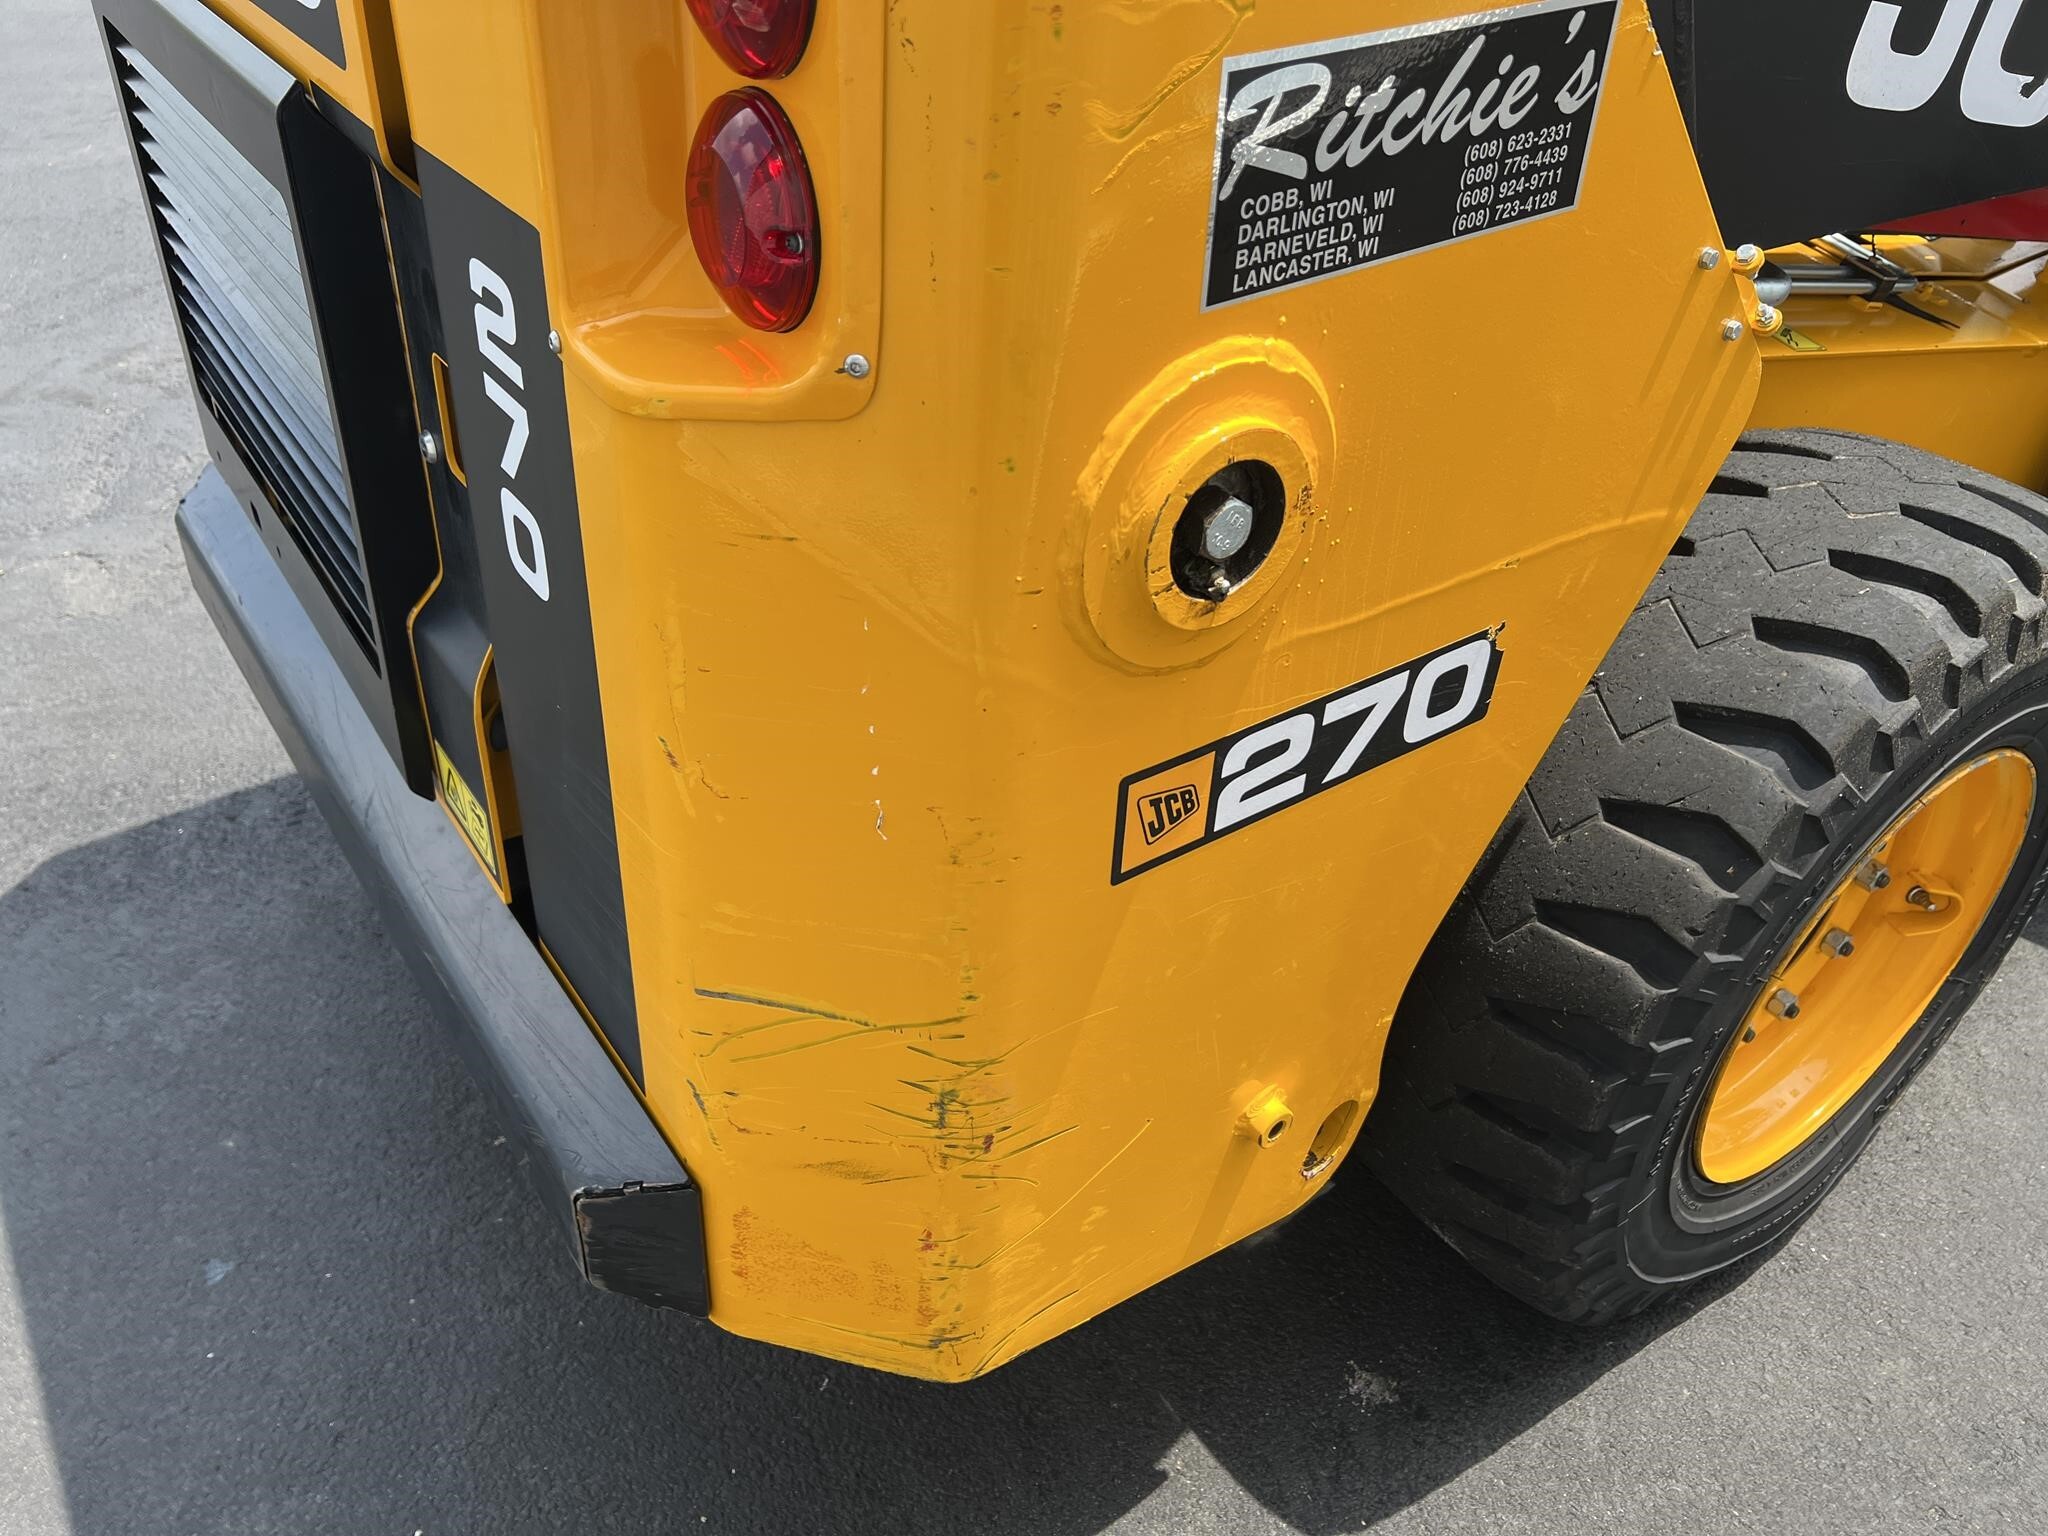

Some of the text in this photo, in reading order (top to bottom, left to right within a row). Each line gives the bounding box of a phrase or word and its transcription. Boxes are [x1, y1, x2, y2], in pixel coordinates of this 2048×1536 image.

[1219, 10, 1598, 201] Ritchie's
[1460, 145, 1568, 190] (608) 776-4439
[1464, 122, 1572, 167] (608) 623-2331
[1237, 187, 1395, 245] DARLINGTON, WI
[1240, 179, 1334, 220] COBB, WI
[1452, 190, 1558, 237] (608) 723-4128
[1456, 167, 1562, 214] (608) 924-9711
[1232, 236, 1379, 293] LANCASTER, WI
[1235, 214, 1384, 270] BARNEVELD, WI
[468, 257, 550, 602] 270
[1147, 639, 1491, 838] JCB 270
